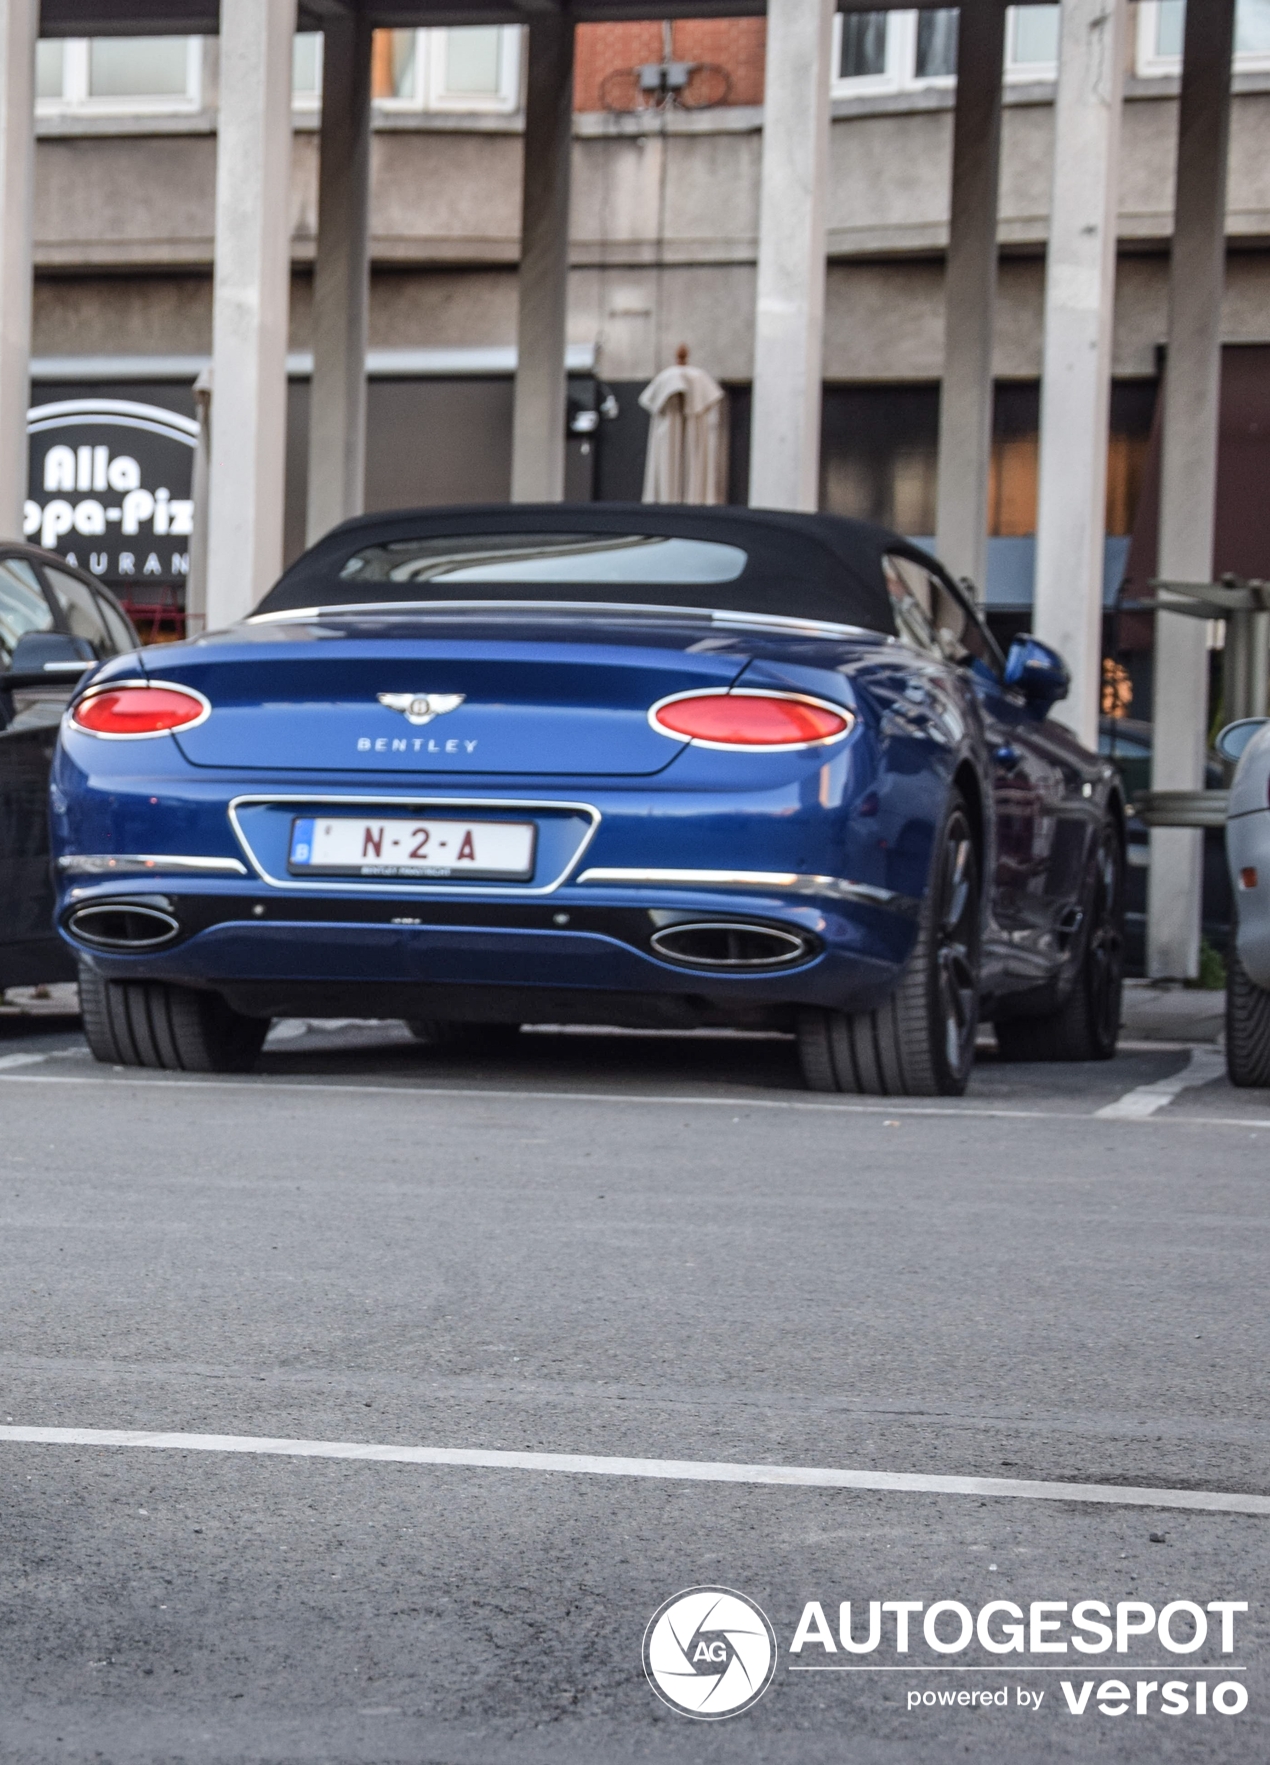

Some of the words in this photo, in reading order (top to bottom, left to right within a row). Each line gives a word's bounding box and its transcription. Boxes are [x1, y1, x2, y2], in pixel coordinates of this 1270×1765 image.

[43, 444, 141, 492] Alla
[357, 737, 478, 753] BENTLEY
[362, 826, 476, 862] N-2-A
